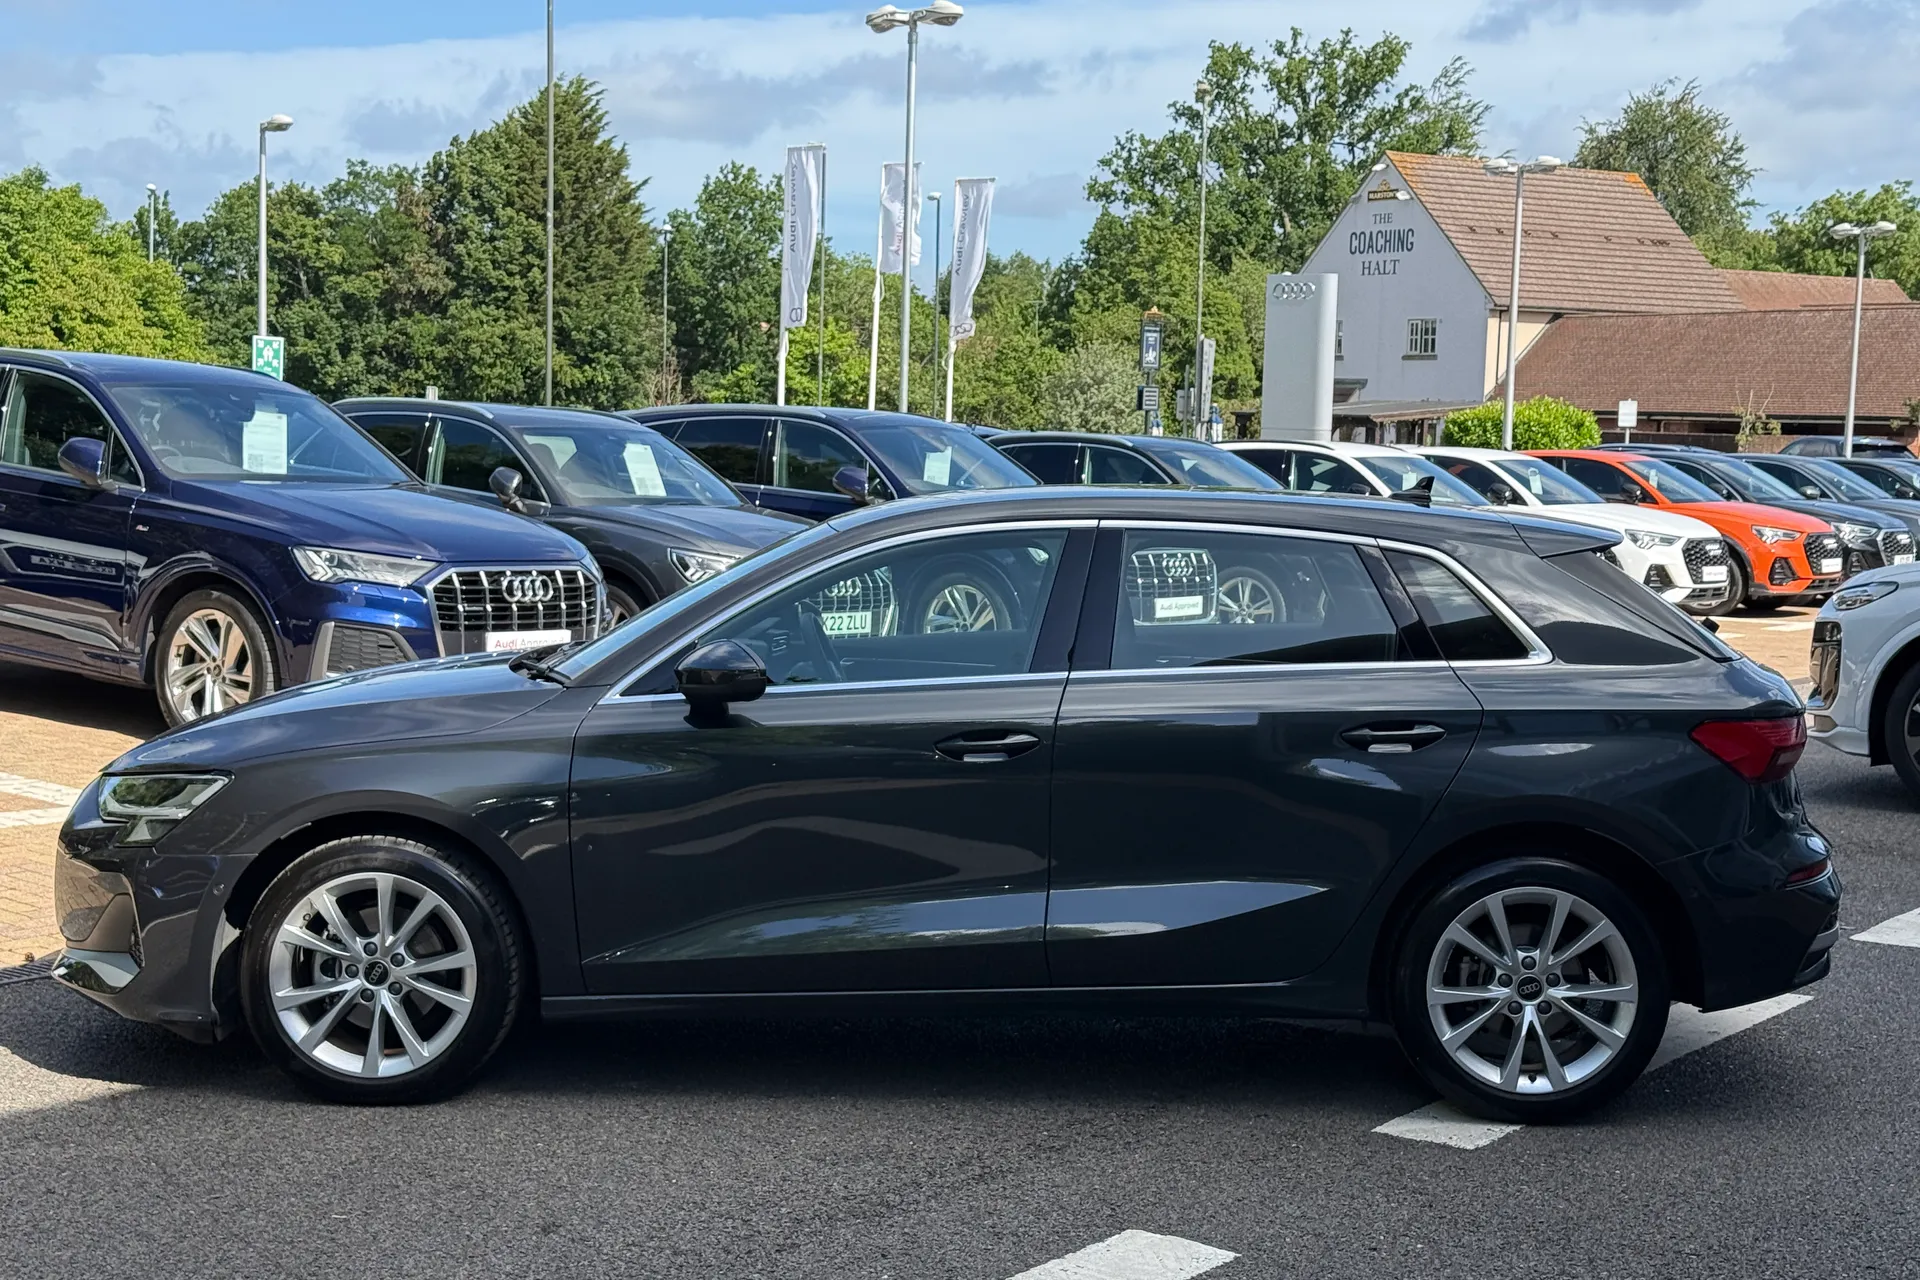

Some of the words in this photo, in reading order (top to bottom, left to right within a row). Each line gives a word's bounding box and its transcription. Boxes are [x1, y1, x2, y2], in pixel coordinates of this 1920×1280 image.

[790, 163, 798, 218] Crawley
[957, 193, 970, 243] Crawley
[1372, 212, 1393, 225] THE
[789, 220, 797, 252] Audi
[1349, 228, 1415, 255] COACHING
[954, 246, 964, 276] Audi
[1360, 259, 1400, 276] HALT
[846, 614, 868, 631] ZLU
[494, 639, 518, 649] Audi
